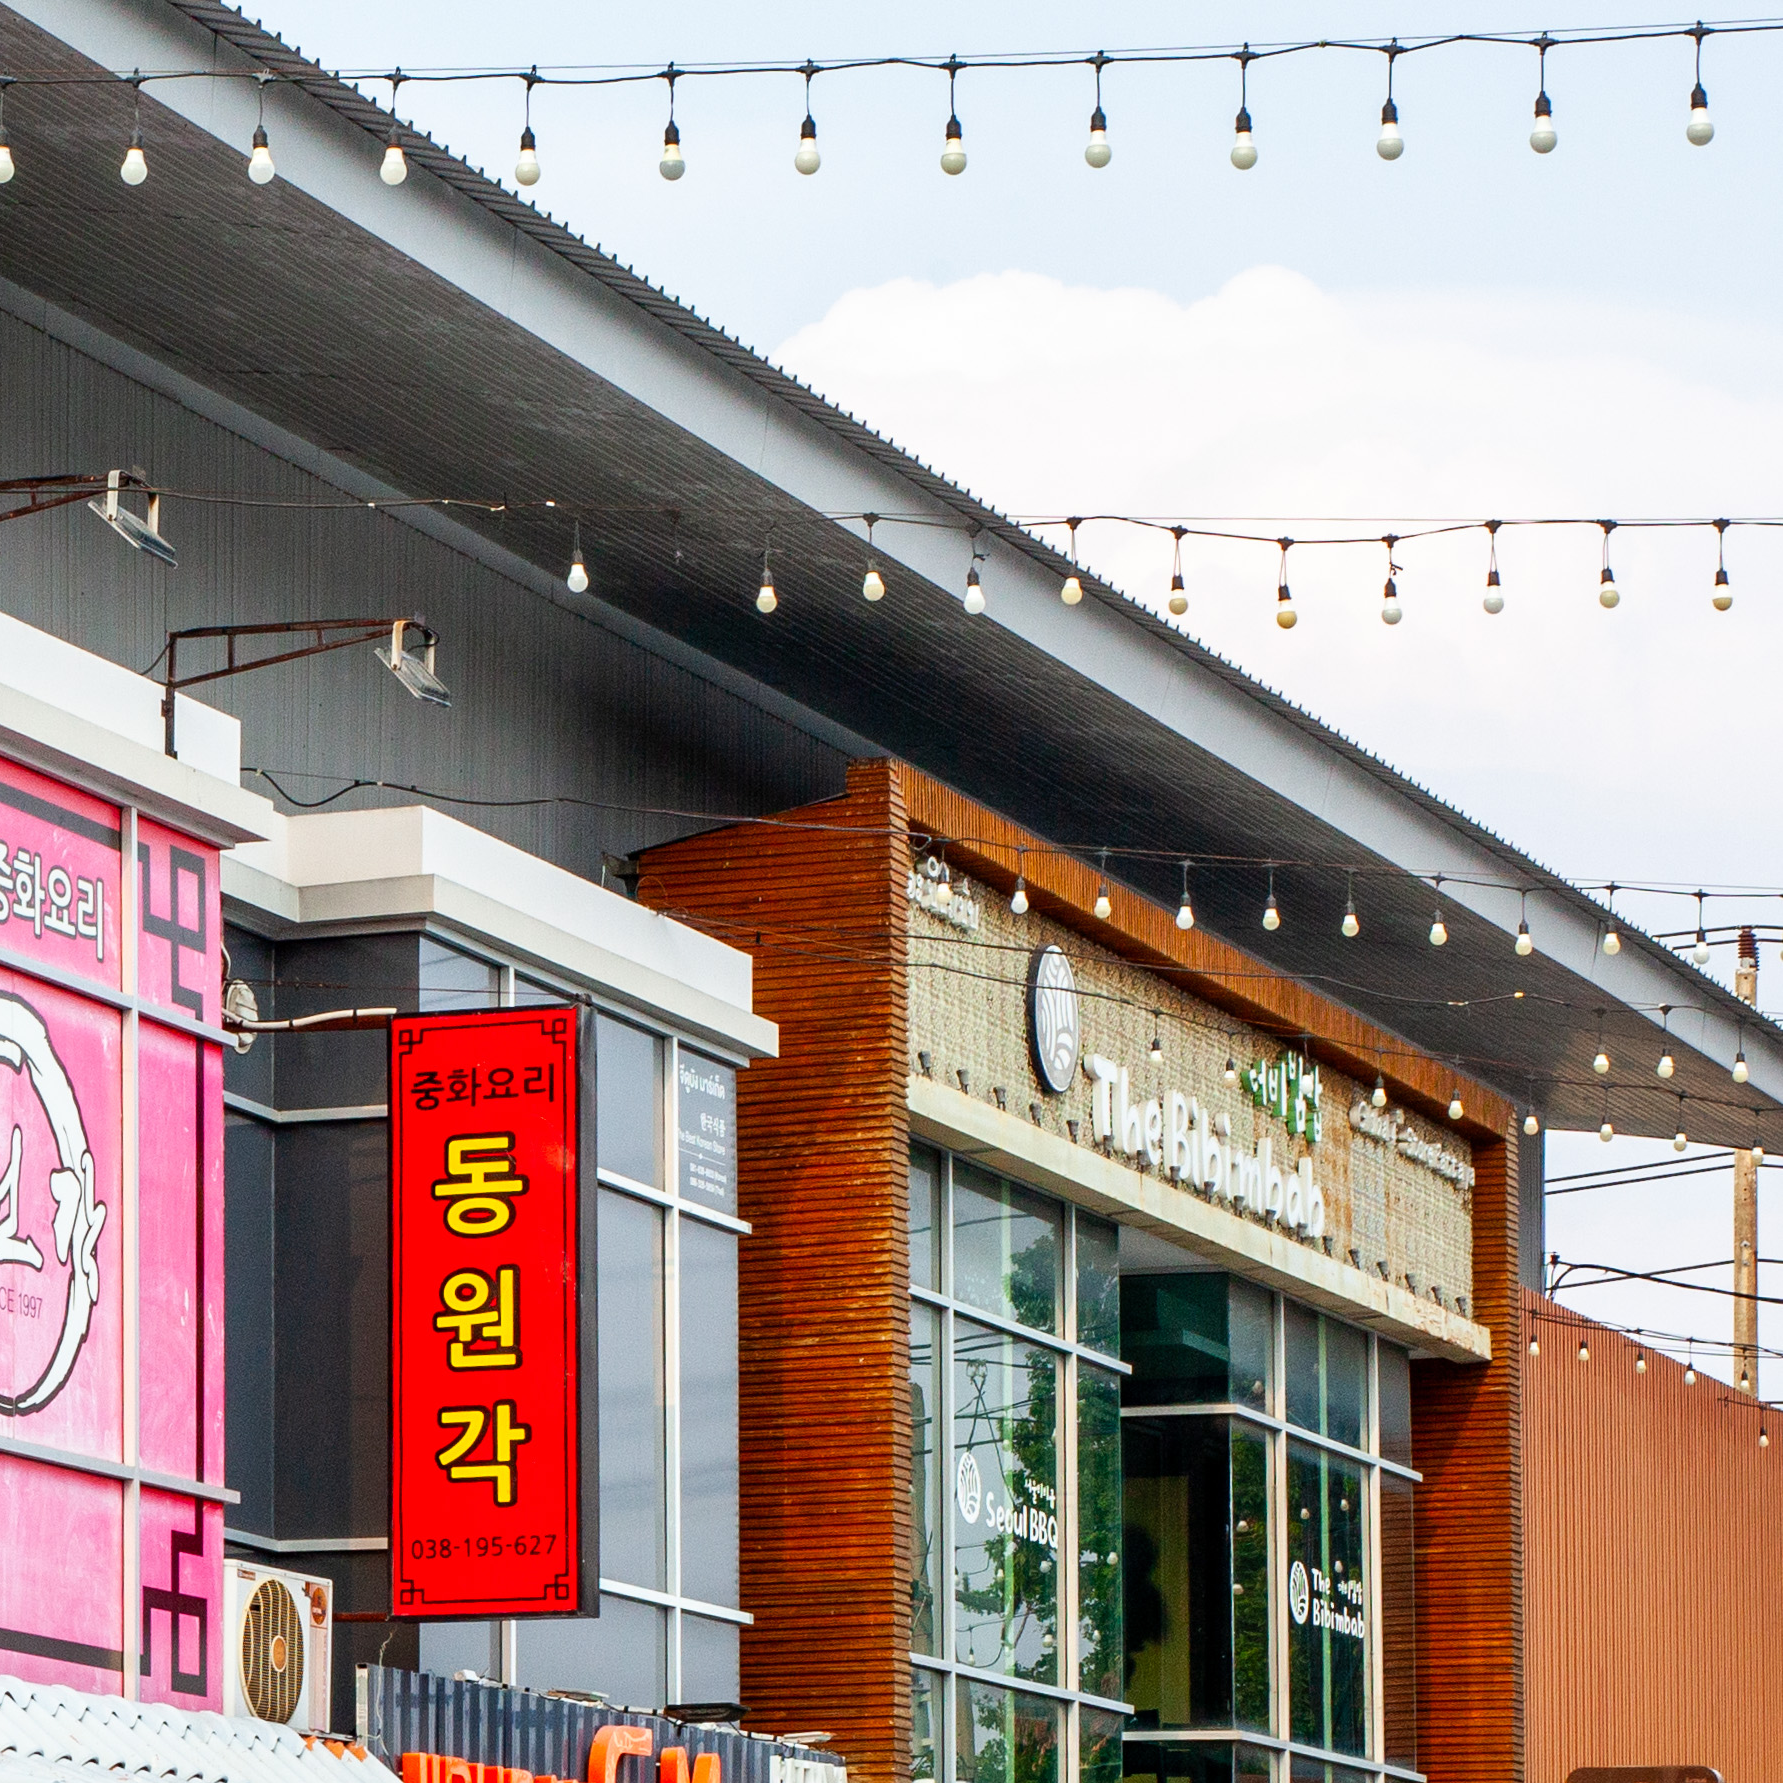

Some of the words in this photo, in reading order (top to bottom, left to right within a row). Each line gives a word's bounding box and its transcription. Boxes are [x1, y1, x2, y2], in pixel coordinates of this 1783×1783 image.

[410, 1062, 556, 1111] 중화요리
[1163, 1089, 1325, 1238] Bibimbab
[18, 1294, 43, 1320] 1997
[431, 1131, 532, 1507] 동원각
[985, 1491, 1028, 1540] Seoul
[1029, 1507, 1058, 1549] BBQ
[410, 1533, 558, 1561] 038-195-627
[1311, 1568, 1331, 1595] The
[1312, 1598, 1365, 1639] Bibimbab
